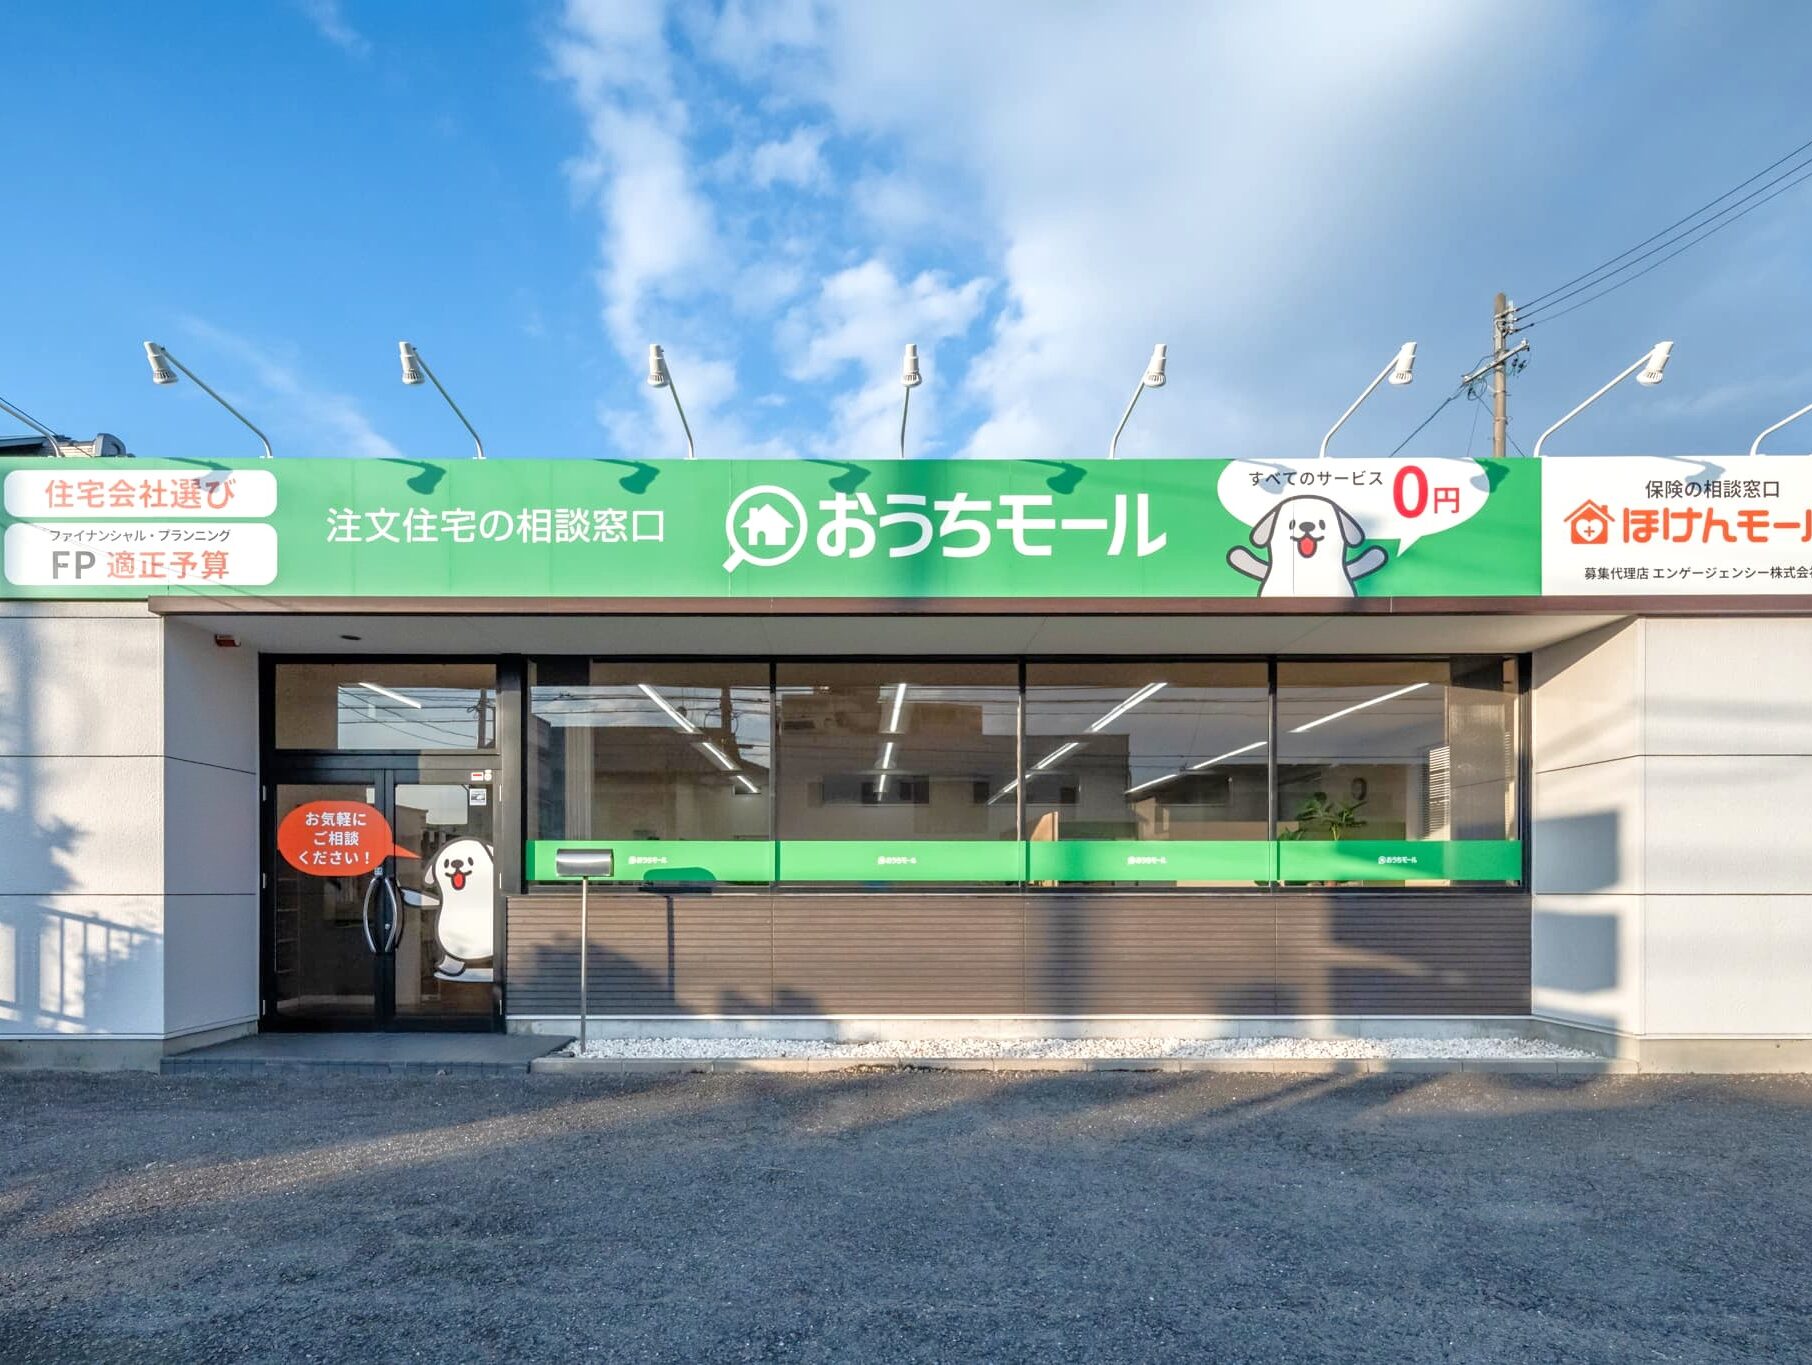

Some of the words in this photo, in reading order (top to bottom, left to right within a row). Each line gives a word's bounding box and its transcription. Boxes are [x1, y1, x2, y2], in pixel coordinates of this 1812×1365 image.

[45, 478, 236, 509] 住宅会社選び
[1249, 471, 1384, 486] すべてのサービス
[1393, 465, 1460, 518] 0円
[1645, 480, 1780, 499] 保険の相談窓口
[51, 529, 230, 542] ファイナンシャル・プランニング
[326, 507, 665, 543] 注文住宅の相談窓口
[816, 491, 1167, 558] おうちモール
[52, 550, 96, 579] FP
[107, 550, 229, 579] 適正予算
[1584, 567, 1649, 580] 募集代理店
[1652, 566, 1812, 580] エンゲージェンシー株式会
[305, 812, 367, 826] お気軽に
[314, 831, 359, 846] ご相談
